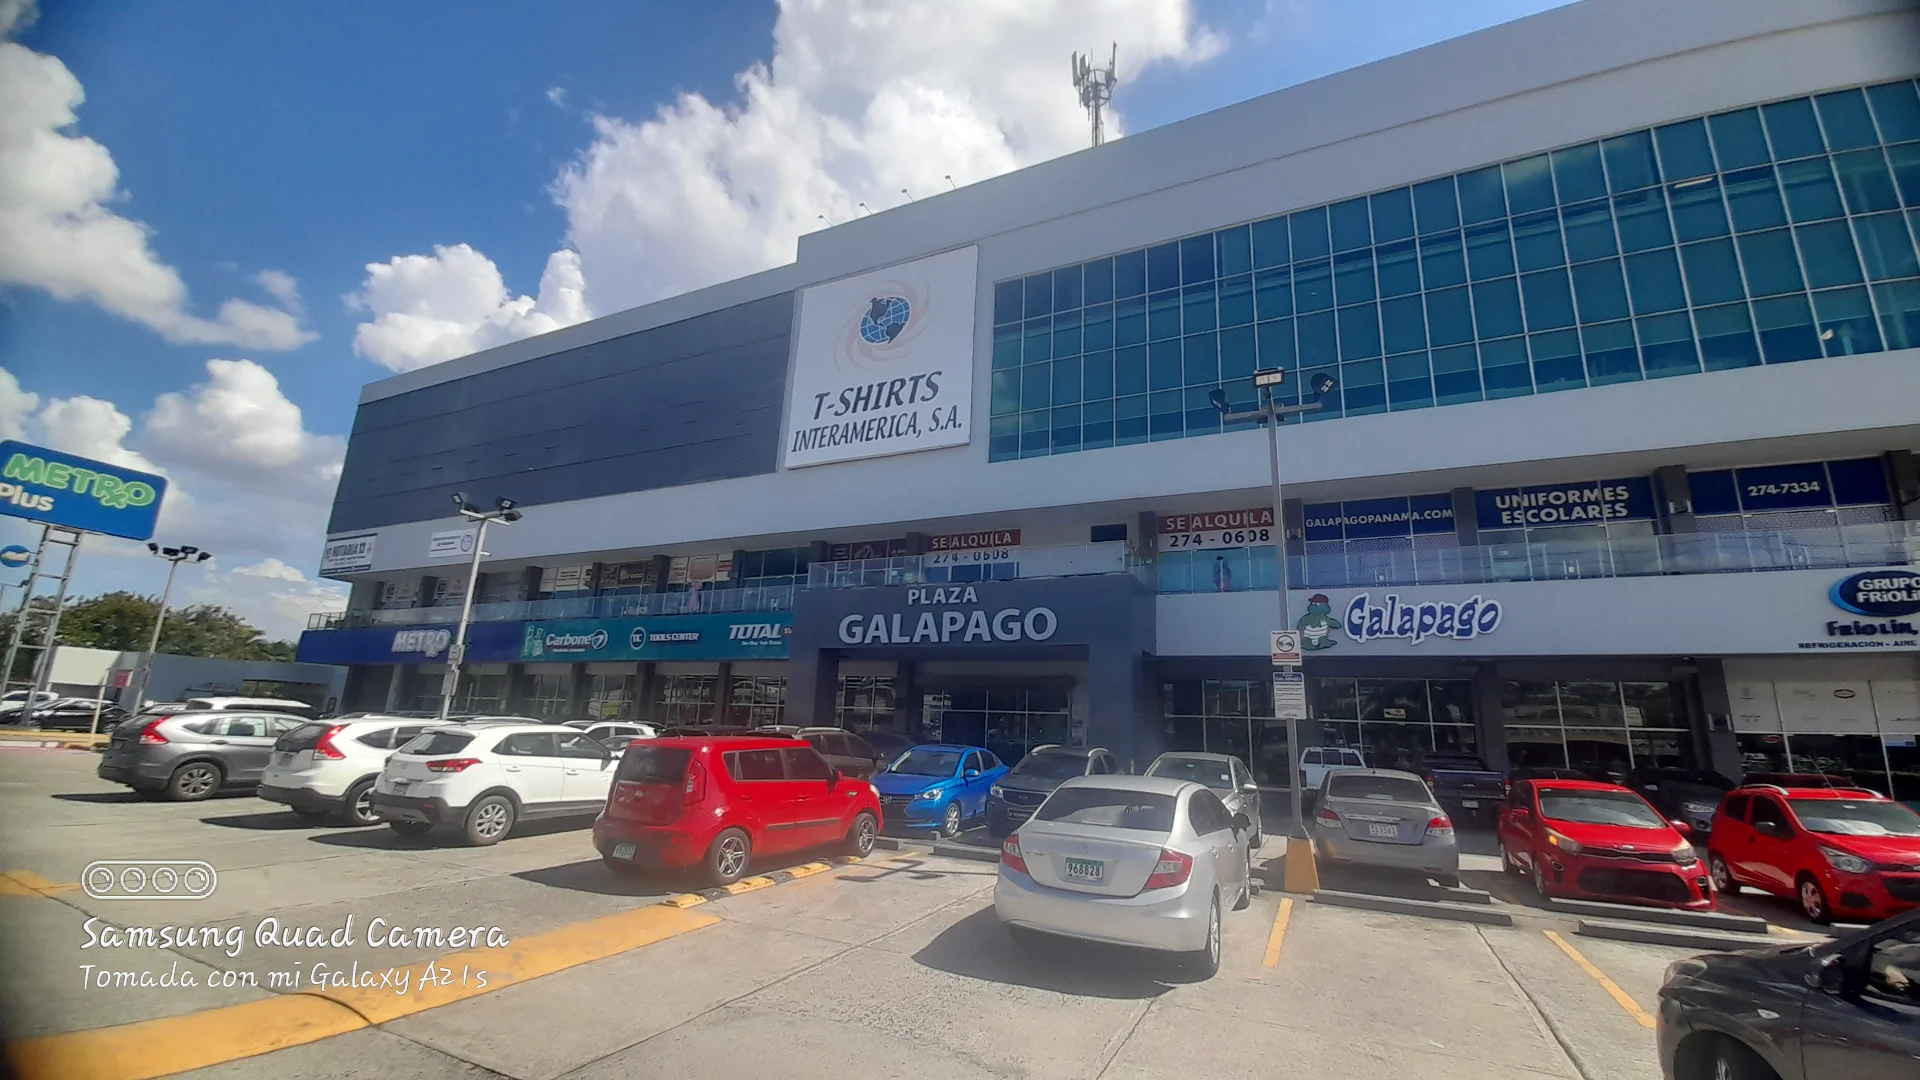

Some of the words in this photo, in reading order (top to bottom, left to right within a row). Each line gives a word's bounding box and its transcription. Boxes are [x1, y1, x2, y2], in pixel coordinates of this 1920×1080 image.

[813, 370, 943, 420] T-SHIRTS
[791, 411, 922, 453] INTERAMERICA,
[928, 405, 962, 432] S.A.
[4, 453, 156, 509] METRO
[1747, 481, 1821, 497] 274-7334
[1495, 485, 1630, 509] UNIFORMES
[1165, 517, 1186, 531] SE
[1191, 510, 1273, 529] ALQUILA
[1305, 508, 1453, 528] GALAPAGOPANAMA.COM
[1501, 502, 1628, 525] ESCOLARES
[931, 536, 947, 550] SE
[951, 531, 1012, 548] ALQUILA
[1169, 533, 1203, 548] 274
[1222, 528, 1270, 545] 0608
[908, 586, 978, 606] PLAZA
[838, 606, 1058, 645] GALAPAGO
[1344, 592, 1502, 645] Galapago
[546, 632, 593, 647] Carbone
[649, 632, 672, 643] TOOLS
[671, 632, 700, 642] CENTER
[729, 623, 783, 640] TOTAL
[391, 628, 452, 658] METRO
[1797, 640, 1885, 650] REFRIGERACION
[1068, 862, 1101, 877] 968828
